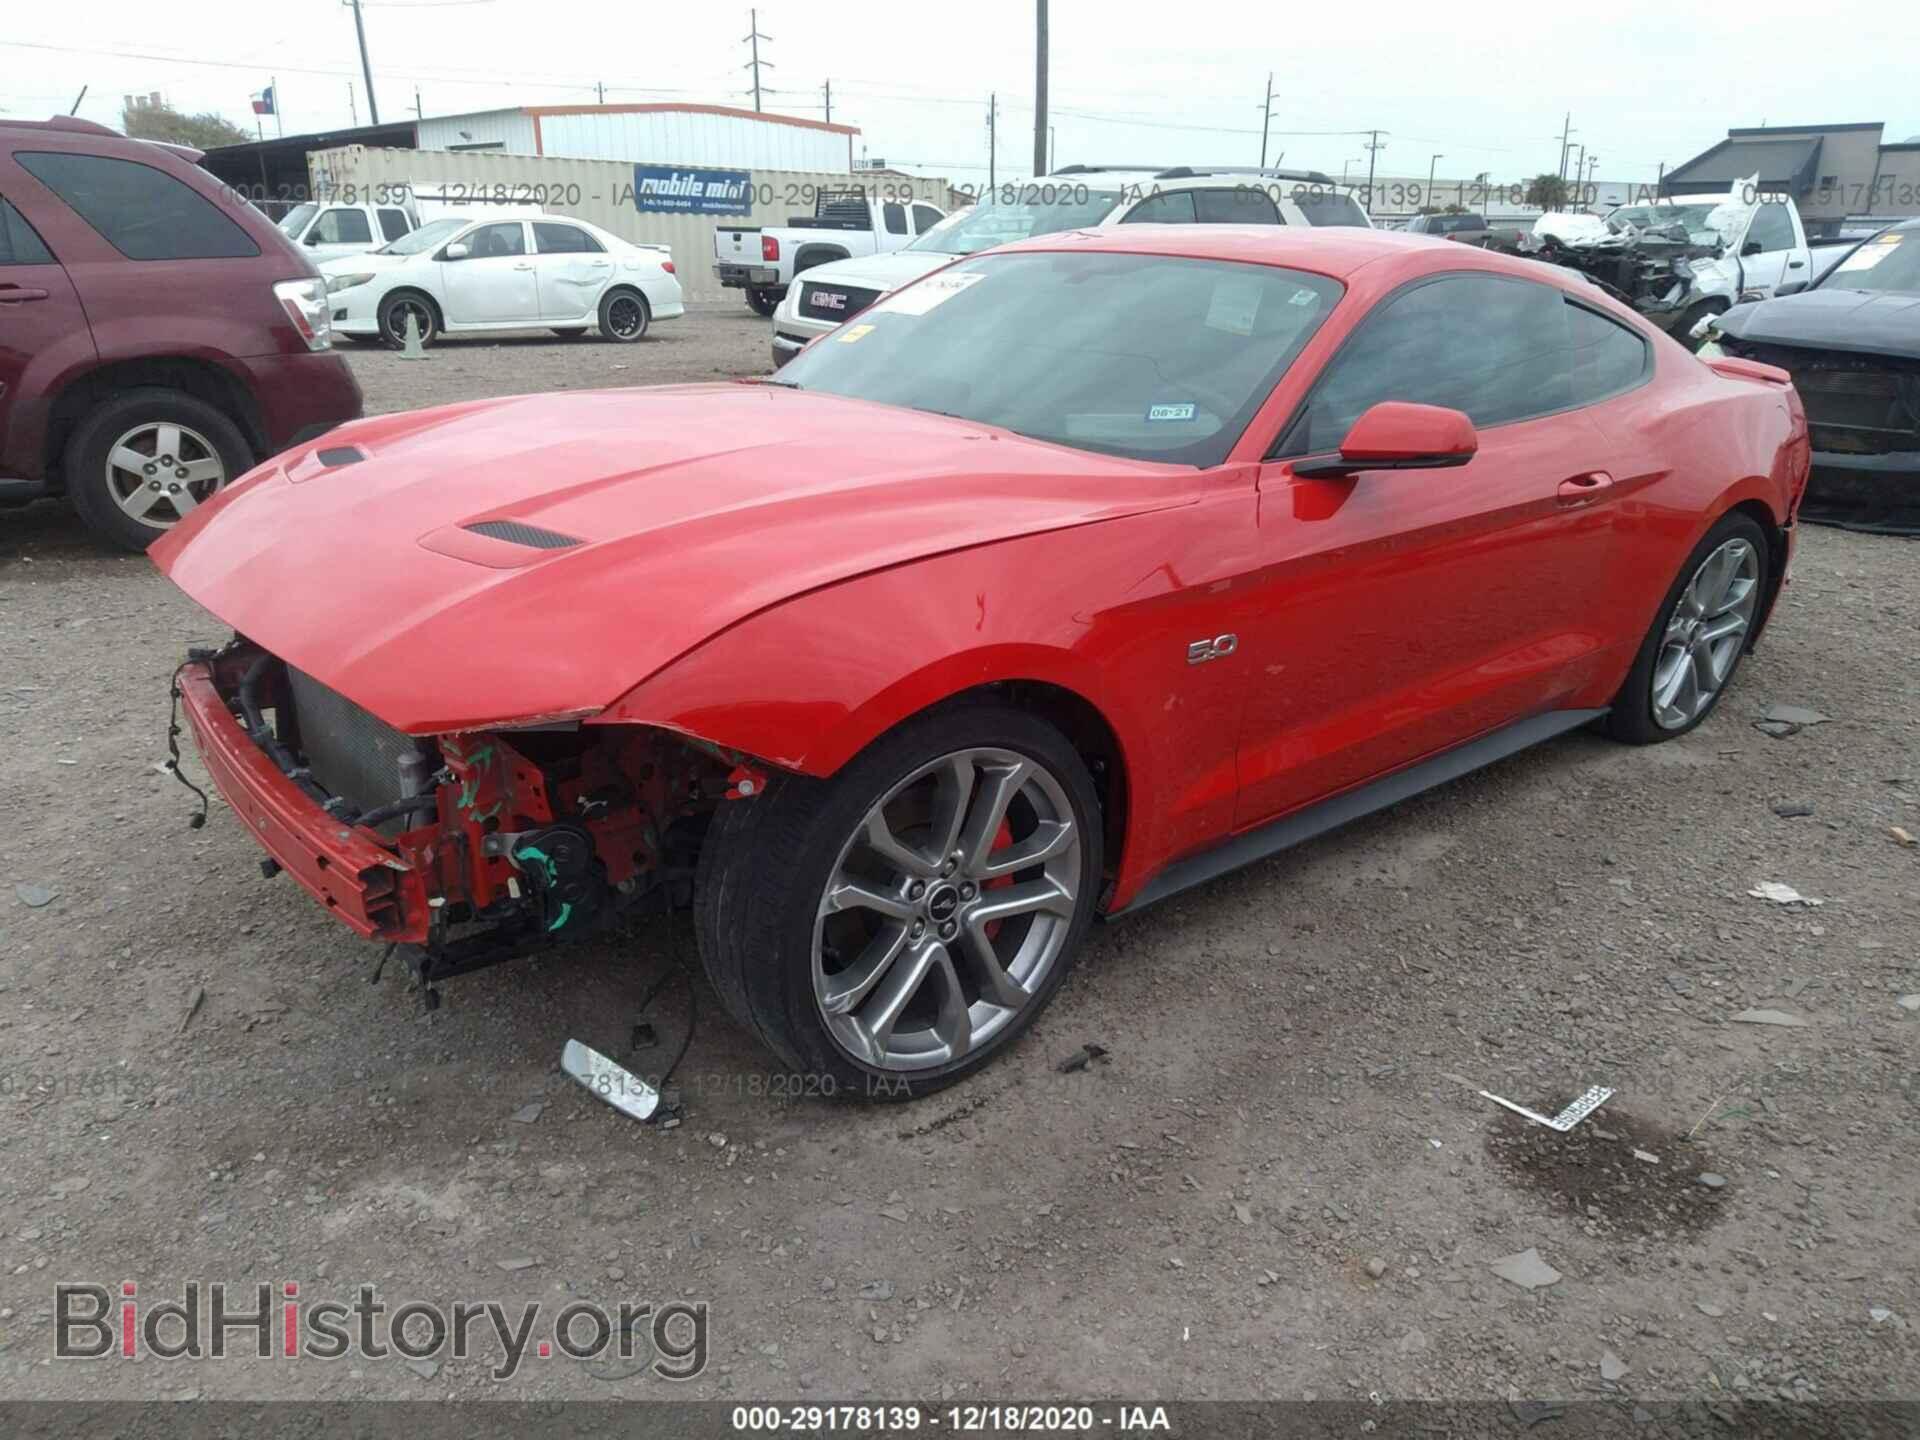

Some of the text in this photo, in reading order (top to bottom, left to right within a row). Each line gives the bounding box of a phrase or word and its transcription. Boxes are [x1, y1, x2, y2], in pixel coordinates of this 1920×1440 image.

[640, 172, 747, 199] mobile mini
[810, 291, 848, 310] GMC
[1187, 633, 1239, 665] 5.0
